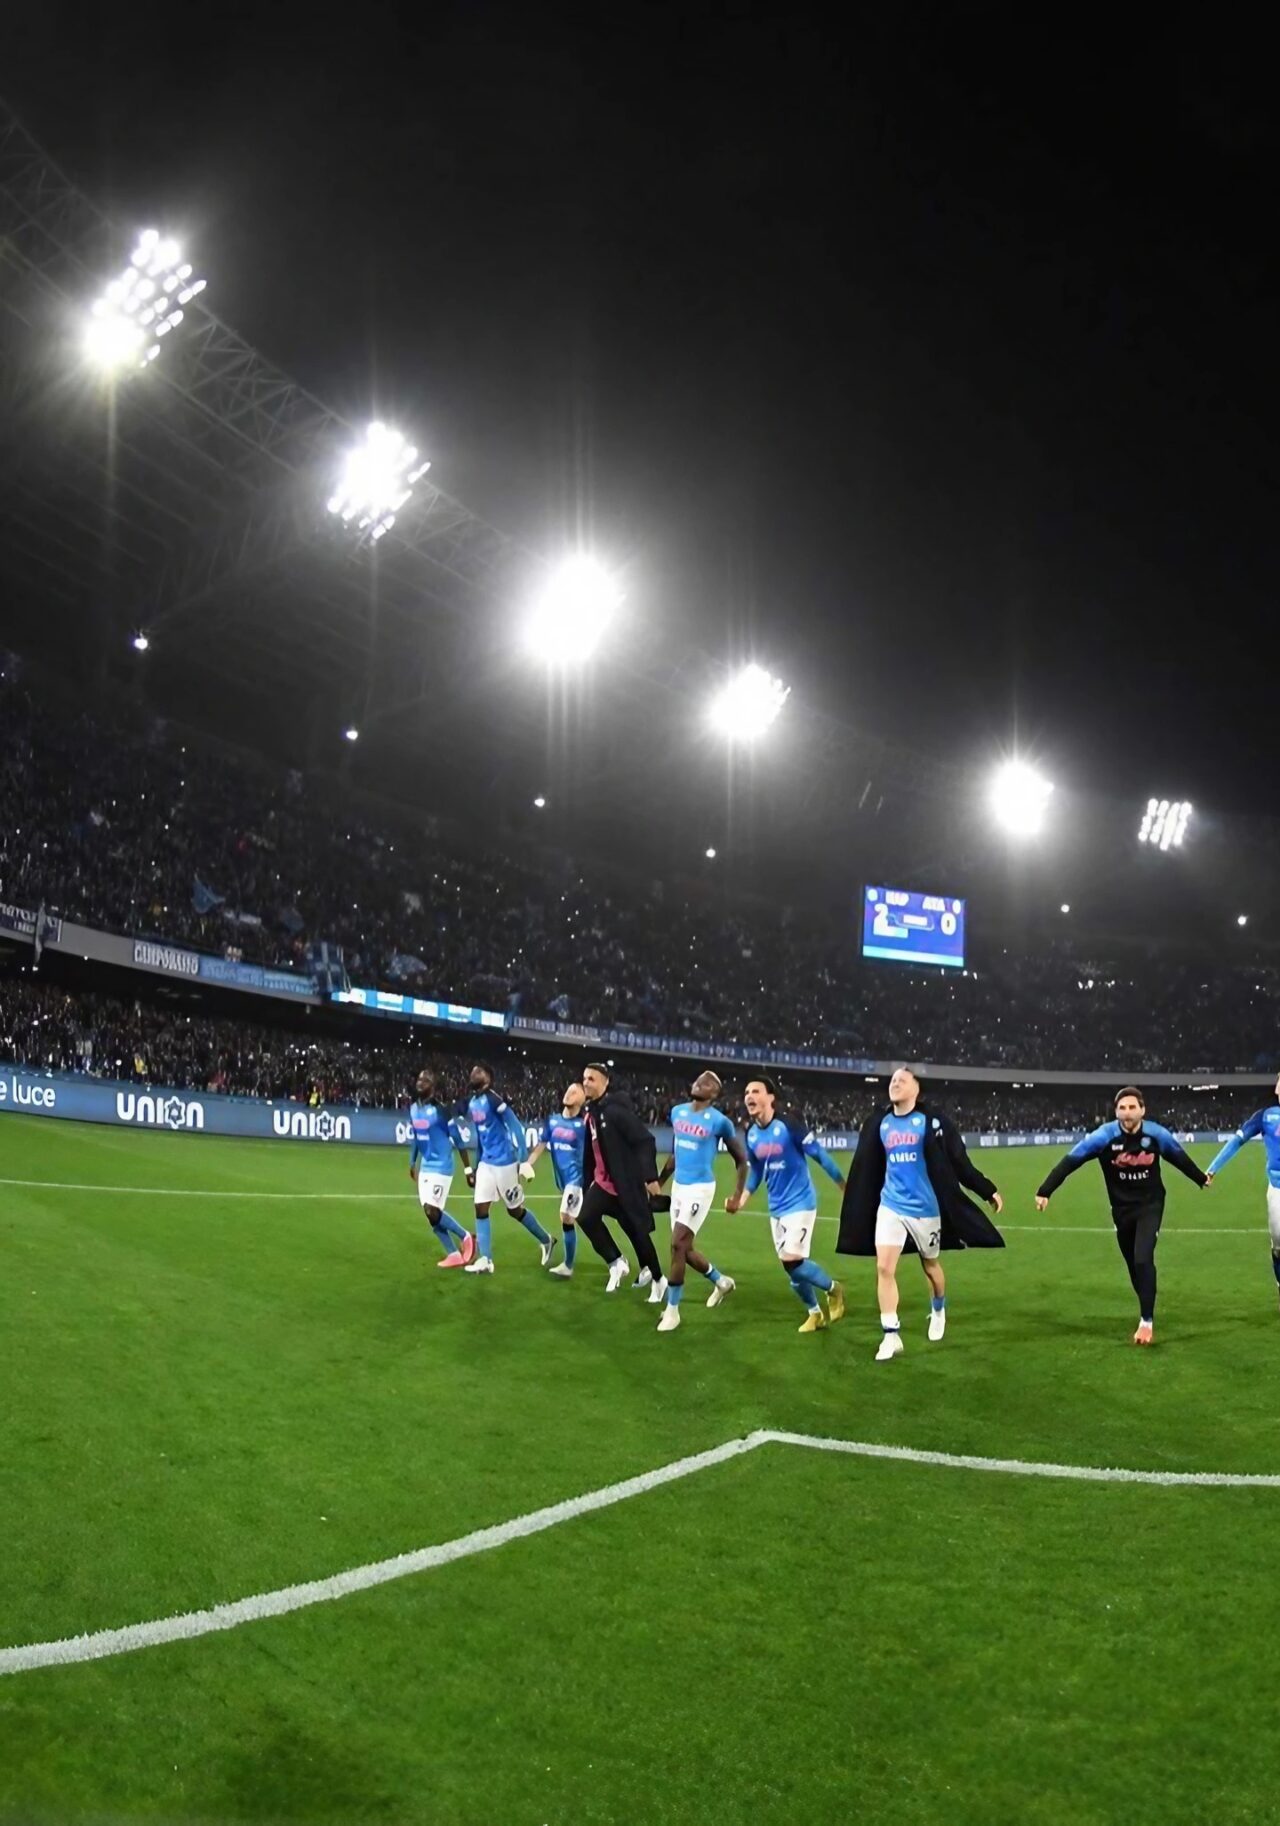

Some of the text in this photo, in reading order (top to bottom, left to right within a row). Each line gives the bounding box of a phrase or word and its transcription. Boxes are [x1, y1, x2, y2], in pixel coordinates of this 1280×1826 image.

[873, 903, 889, 937] 2
[941, 912, 957, 936] 0
[13, 1076, 56, 1107] luce
[117, 1092, 204, 1130] UNION
[273, 1110, 350, 1141] UNION
[690, 1202, 700, 1217] 9
